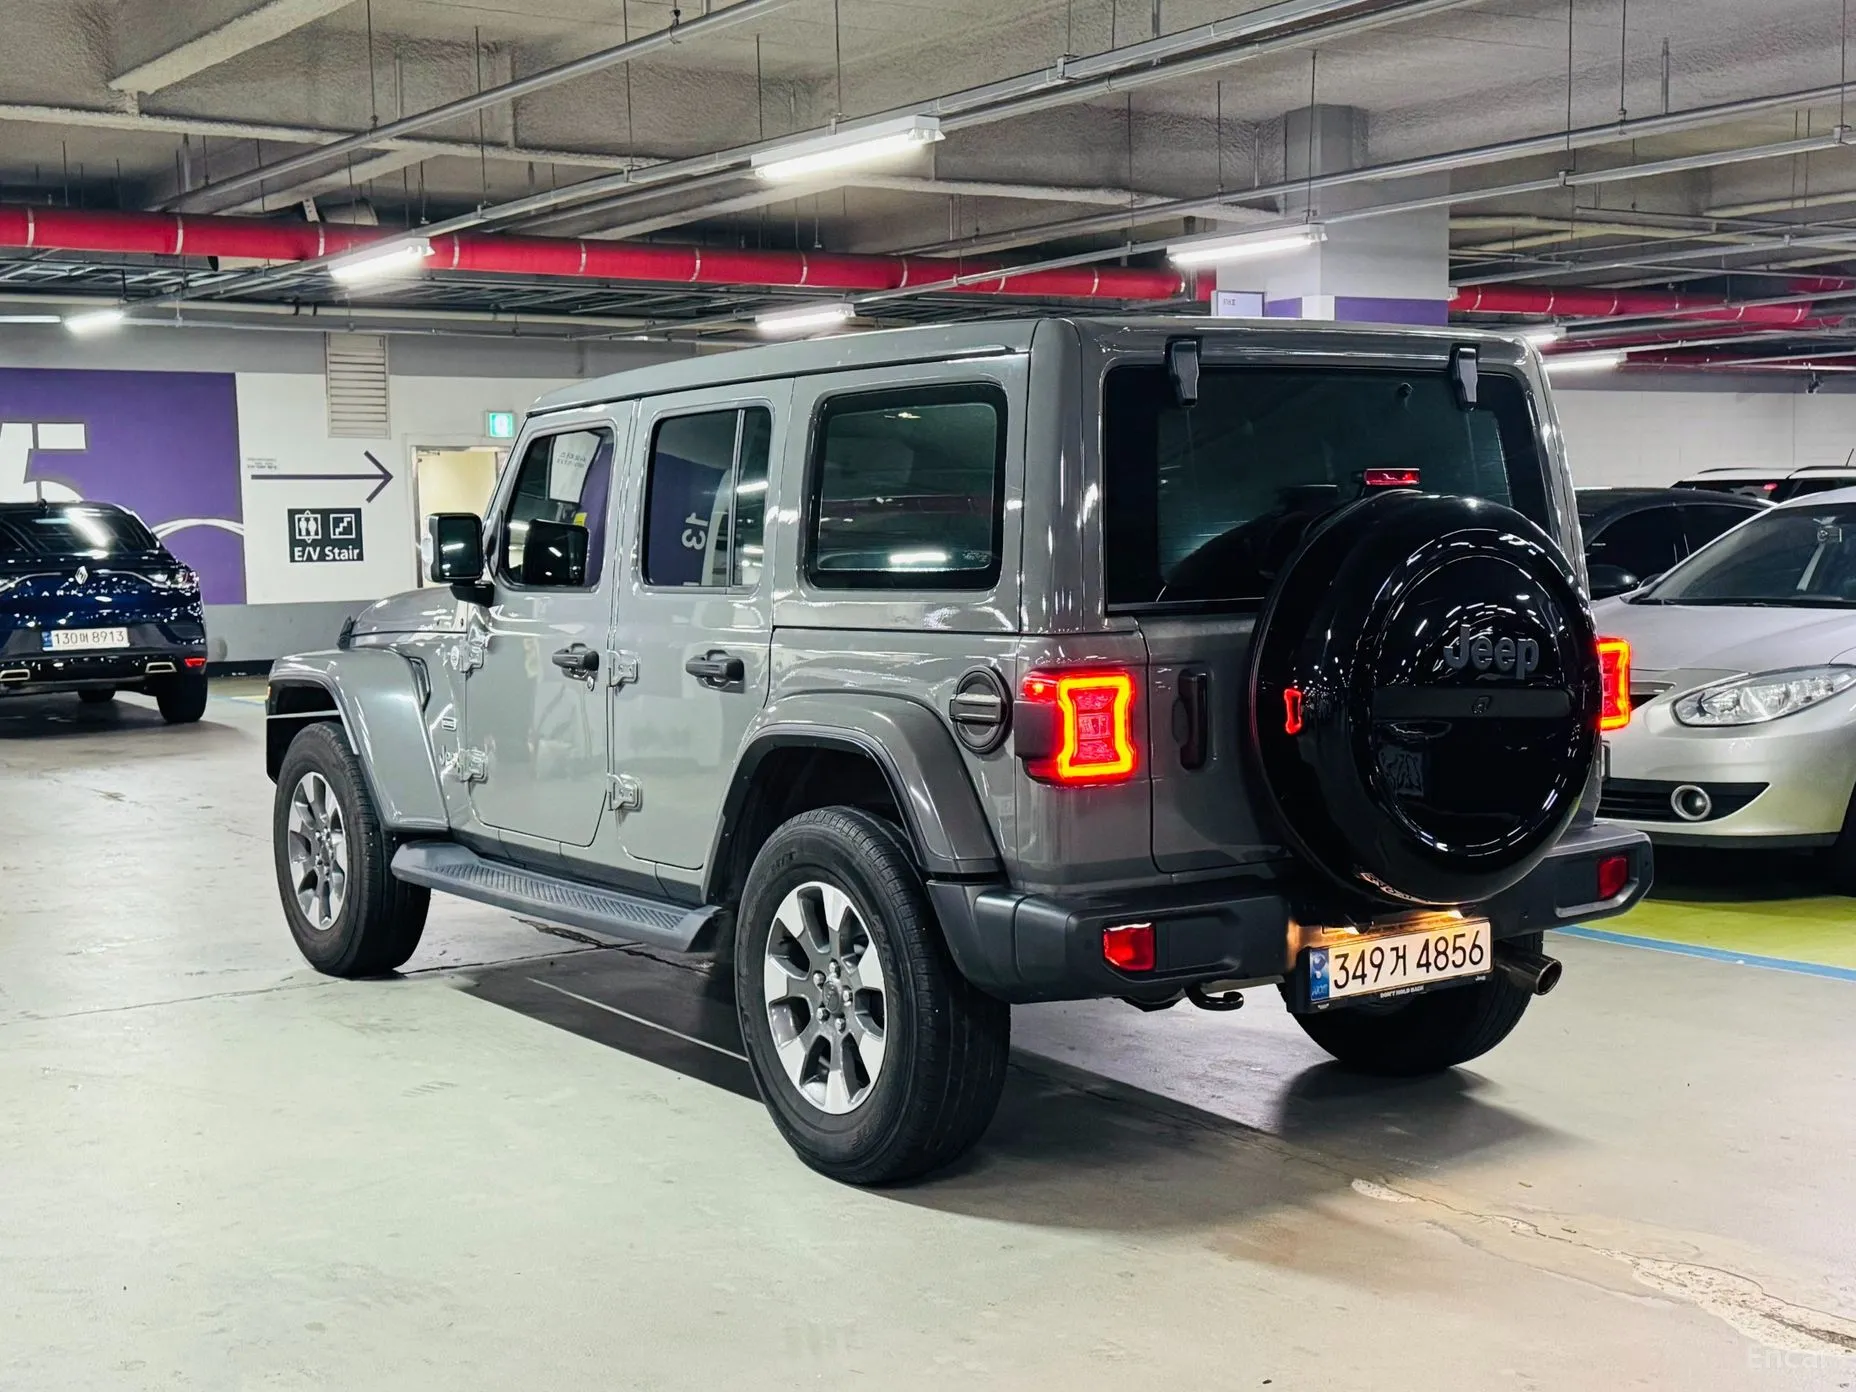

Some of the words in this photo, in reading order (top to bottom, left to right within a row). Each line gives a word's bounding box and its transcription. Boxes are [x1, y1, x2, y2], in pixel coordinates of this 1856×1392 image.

[294, 546, 321, 561] E/V
[325, 545, 360, 560] Stair
[92, 630, 125, 643] 8913
[1443, 624, 1540, 680] Jeep
[1333, 944, 1407, 990] 349거
[1416, 929, 1484, 974] 4856
